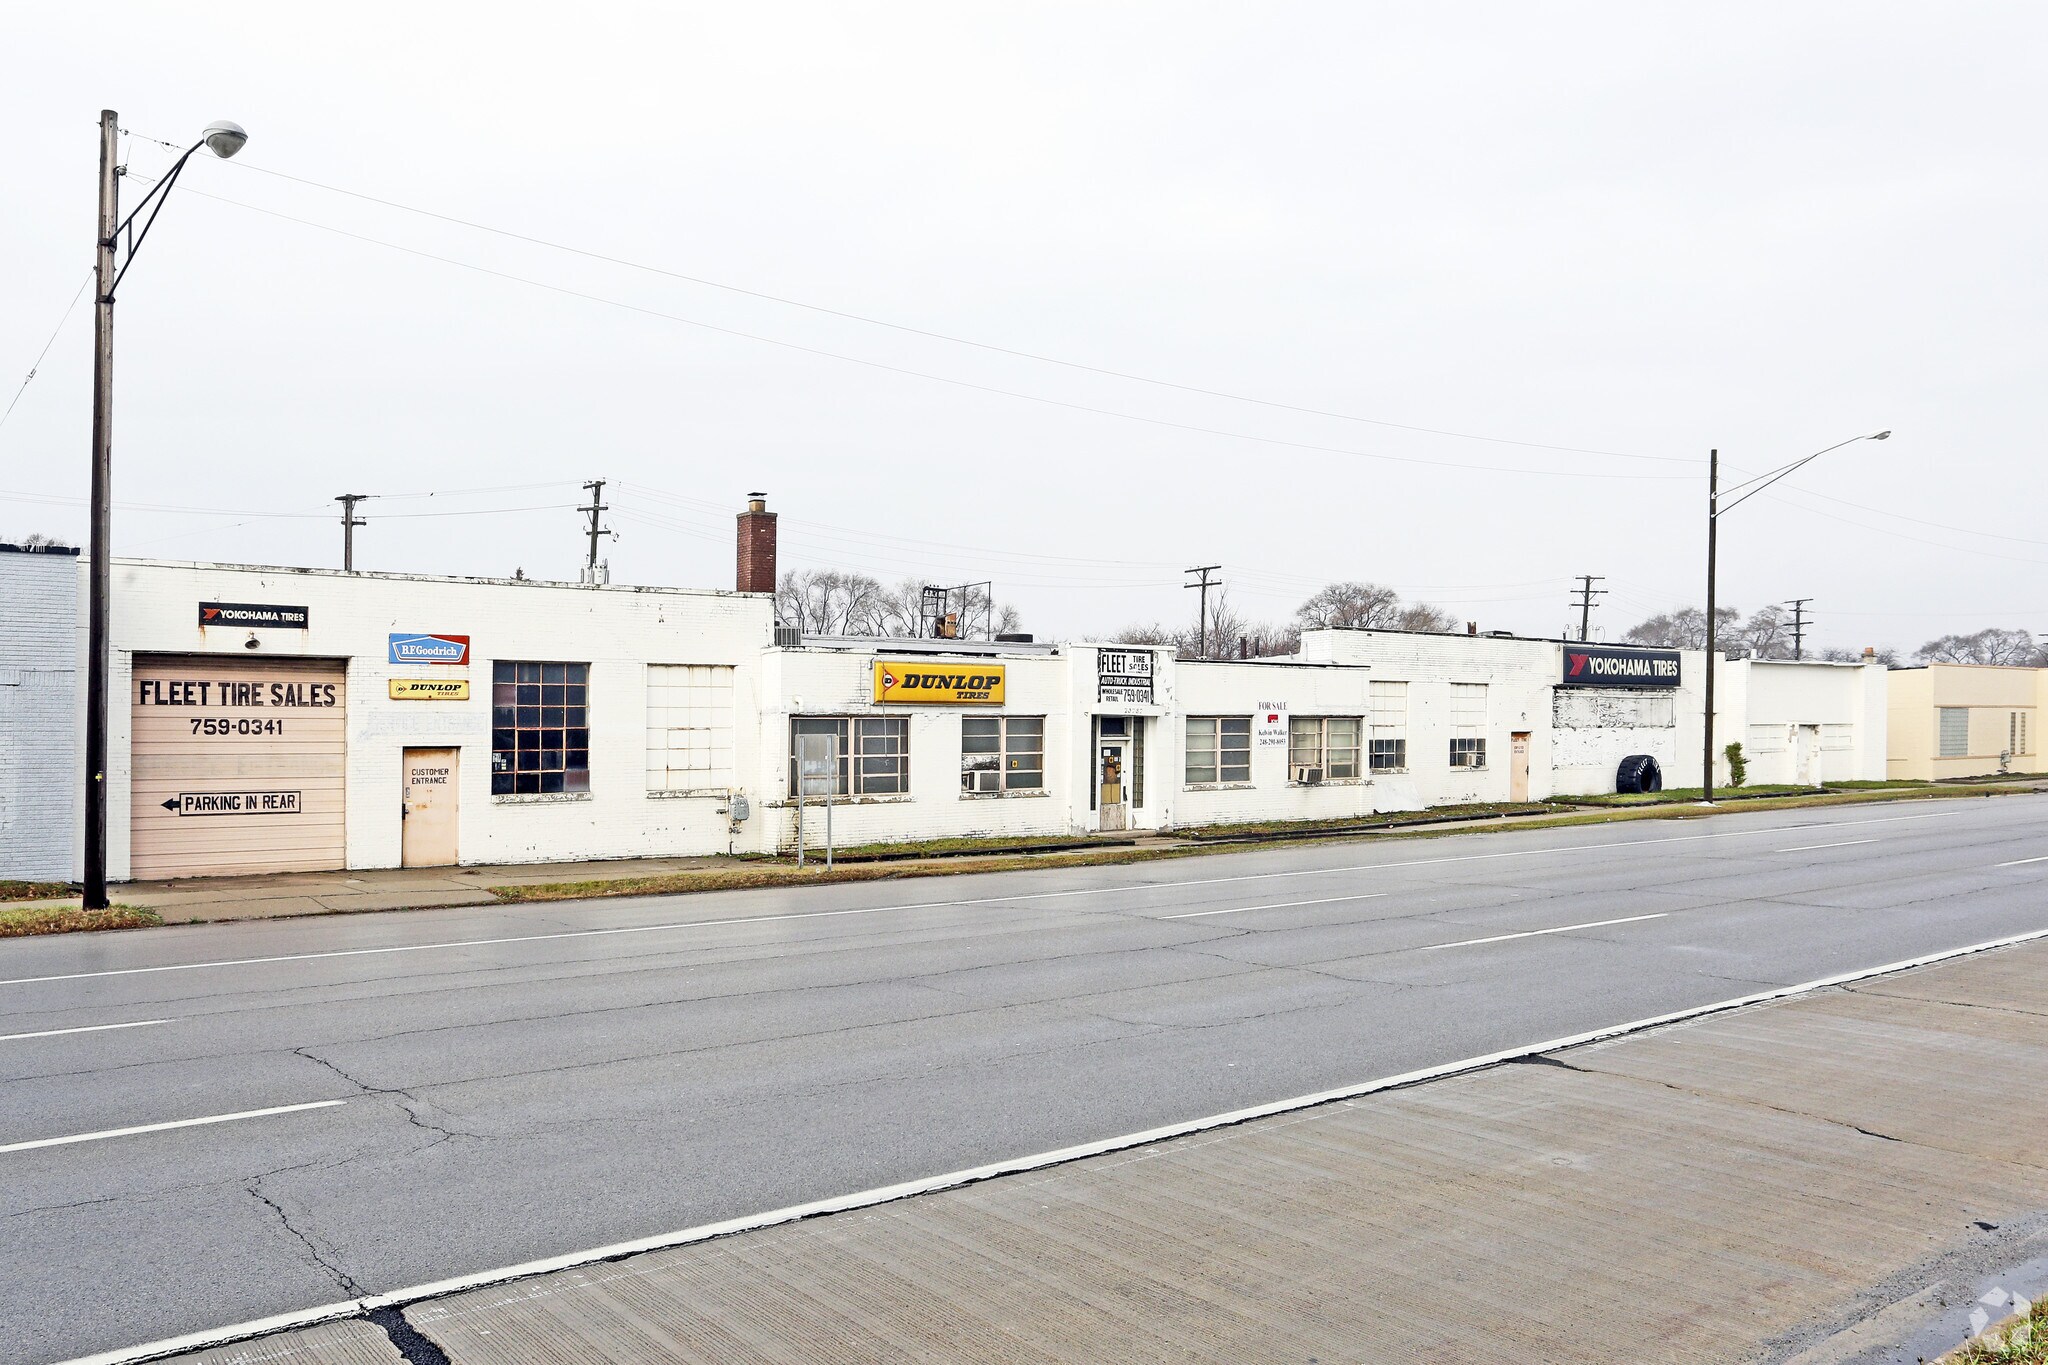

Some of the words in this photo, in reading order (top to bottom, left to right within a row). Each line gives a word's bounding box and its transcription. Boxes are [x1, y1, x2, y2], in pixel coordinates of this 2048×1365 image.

[220, 609, 279, 621] YOKOHAMA
[280, 612, 305, 622] TIRES
[1102, 654, 1126, 673] FLEET
[1589, 657, 1651, 676] YOKOHAMA
[1653, 660, 1678, 677] TIRES
[901, 674, 1001, 690] DUNLOP
[140, 681, 210, 705] FLEET
[218, 682, 264, 706] TIRE
[270, 683, 335, 707] SALES
[1123, 689, 1150, 703] 759-0341
[1259, 702, 1271, 710] FOR
[1272, 702, 1287, 710] SALE
[190, 718, 283, 736] 759-0341
[411, 768, 450, 776] CUSTOMER
[411, 776, 448, 785] ENTRANCE
[185, 796, 241, 812] PARKING
[245, 795, 258, 810] IN
[262, 794, 296, 809] REAR
